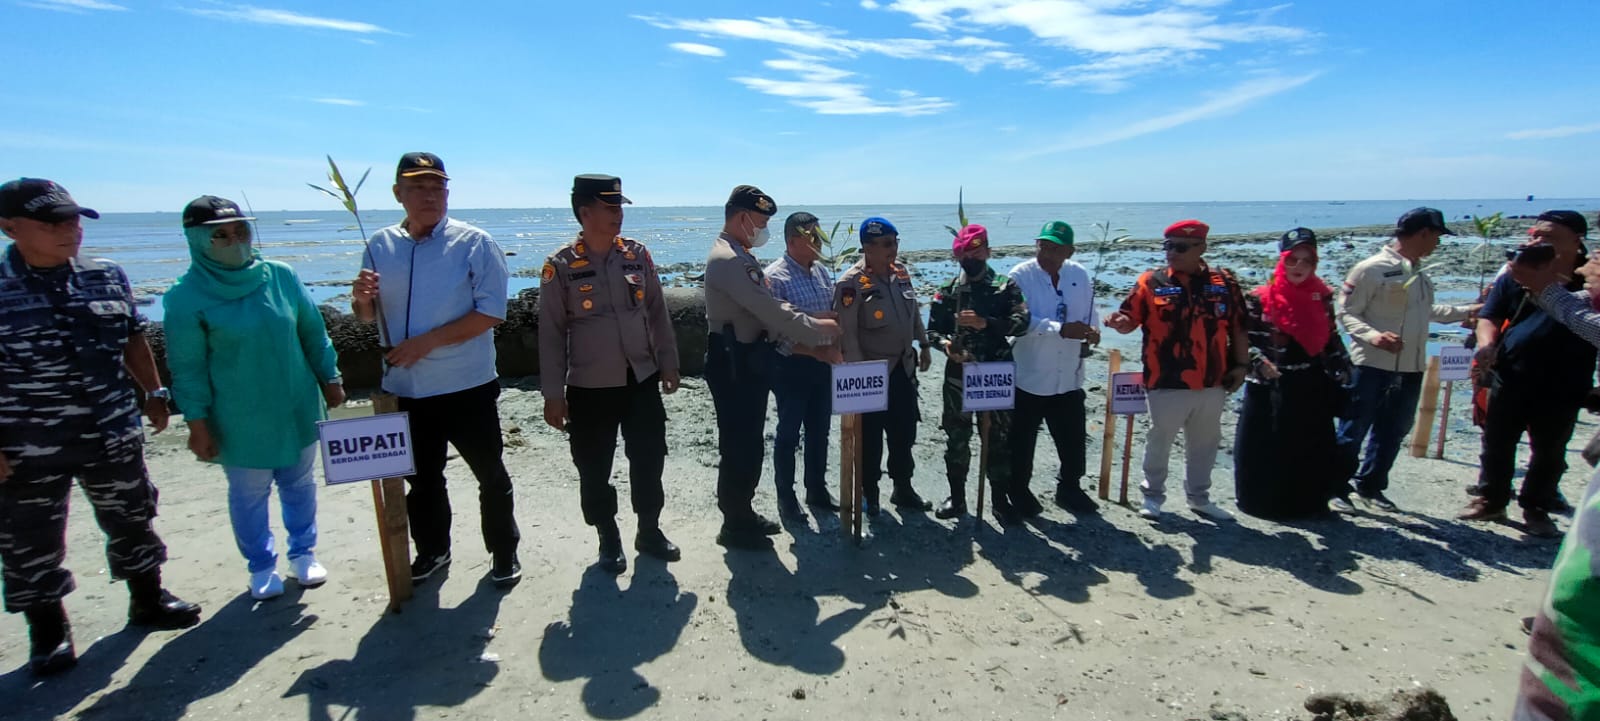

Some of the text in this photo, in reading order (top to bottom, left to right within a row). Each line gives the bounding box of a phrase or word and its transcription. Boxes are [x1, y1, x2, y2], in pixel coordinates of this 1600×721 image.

[836, 376, 884, 392] KAPOLRES
[966, 374, 1012, 388] DAN SATGAS
[1116, 384, 1140, 395] KETUA
[328, 432, 406, 456] BUPATI
[331, 450, 406, 464] SERDANG BEDAGAI
